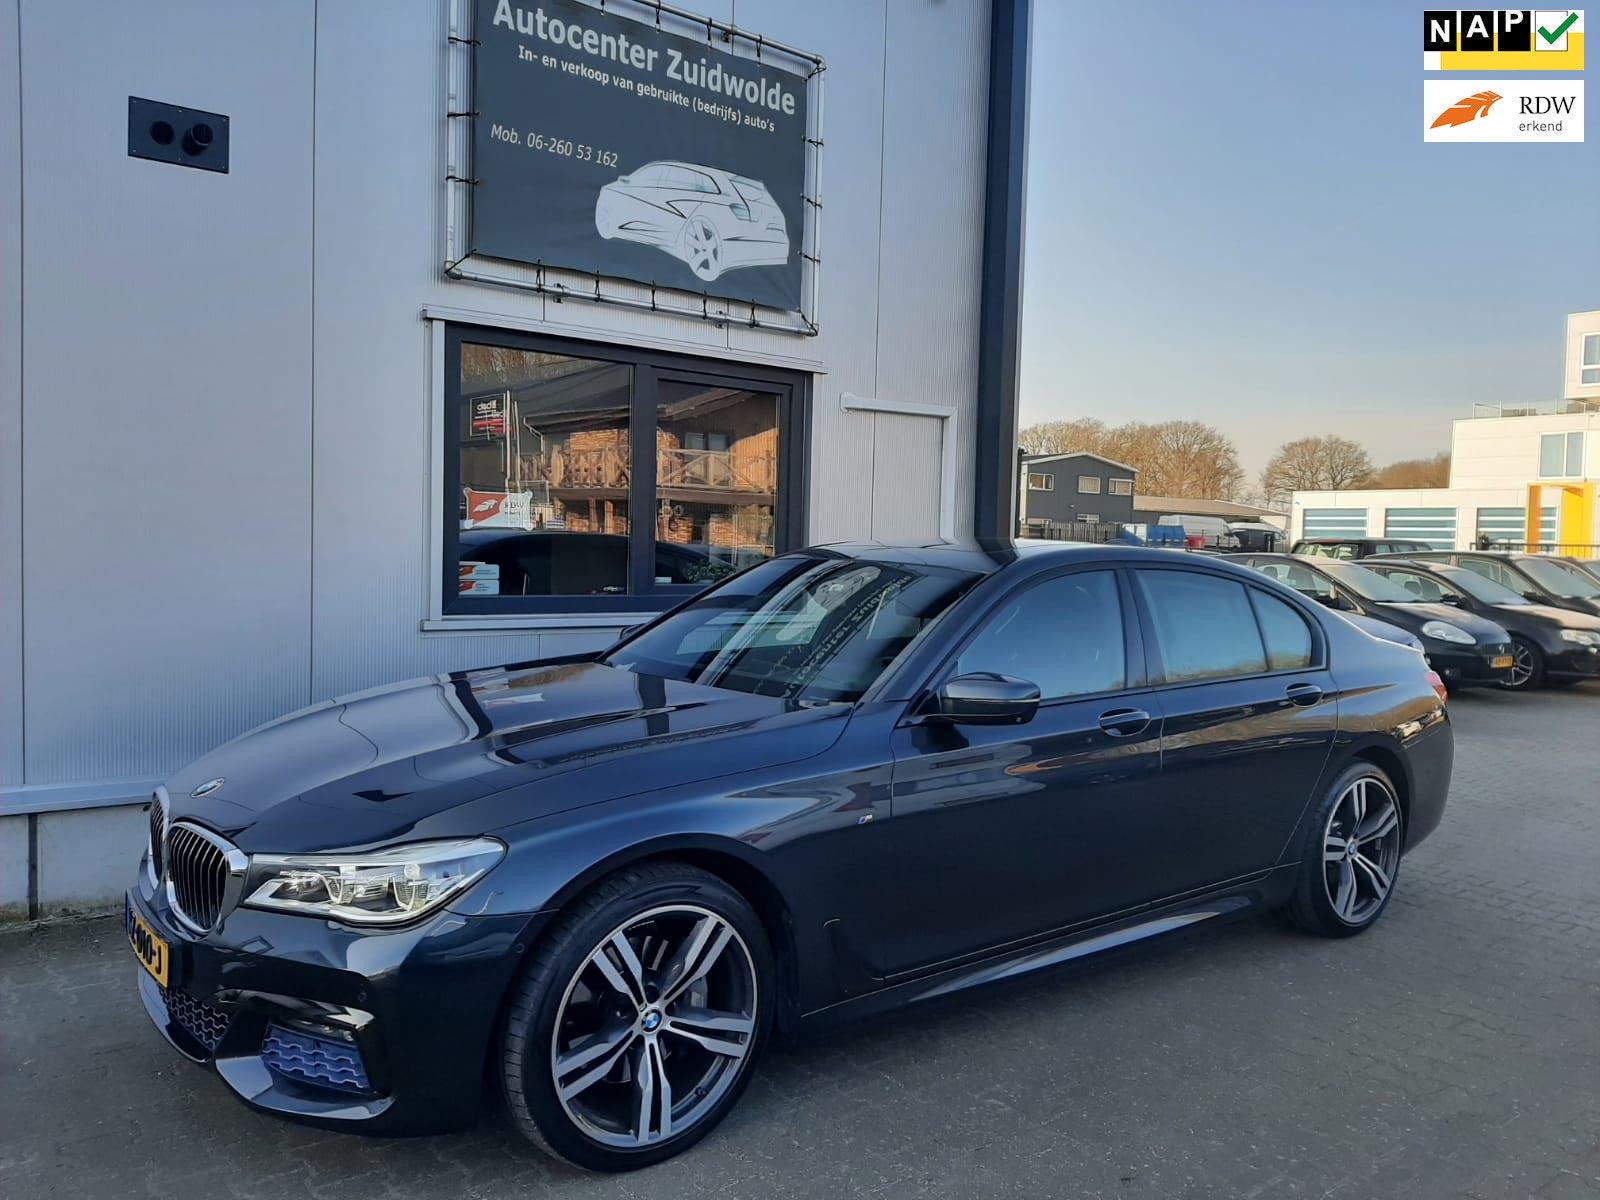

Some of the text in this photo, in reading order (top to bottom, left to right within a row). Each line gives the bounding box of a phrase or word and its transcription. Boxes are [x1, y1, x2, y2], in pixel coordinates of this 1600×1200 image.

[493, 0, 795, 115] Autocenter Zuidwolde
[518, 45, 775, 132] In- en verkoop van gebruikte (bedrijfs) auto's
[490, 123, 618, 168] Mob. 06-260 53 162
